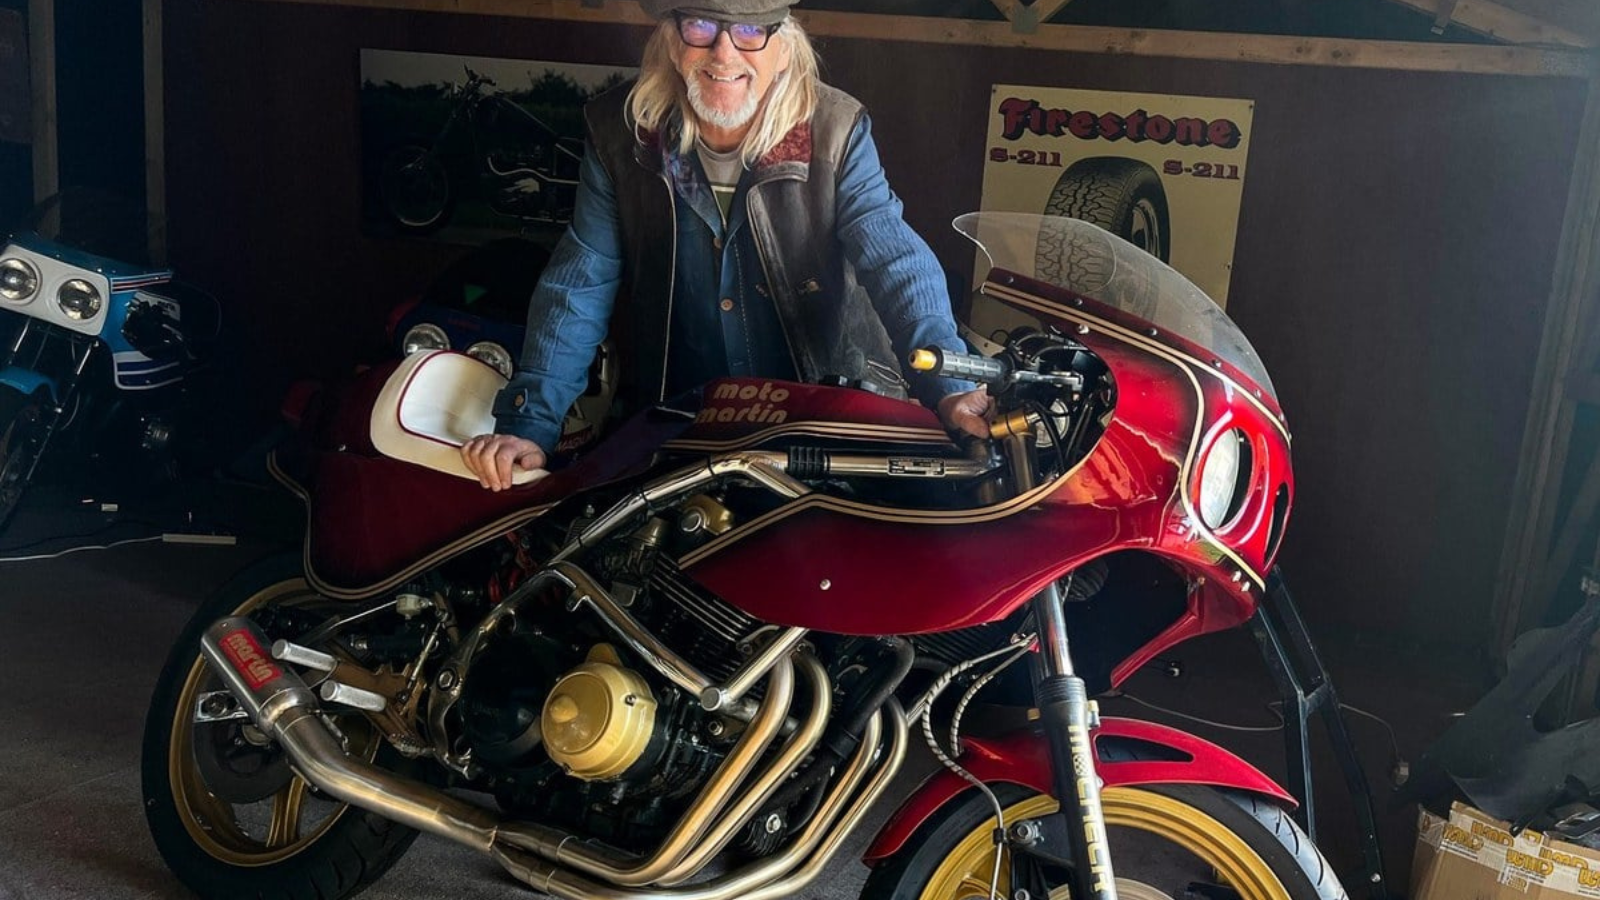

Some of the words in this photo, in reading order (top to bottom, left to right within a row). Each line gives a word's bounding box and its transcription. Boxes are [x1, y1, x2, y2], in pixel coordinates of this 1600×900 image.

[999, 97, 1241, 149] Firestone
[989, 147, 1063, 168] S-211
[1163, 159, 1240, 180] S-211
[713, 382, 789, 402] moto
[697, 403, 788, 424] martin
